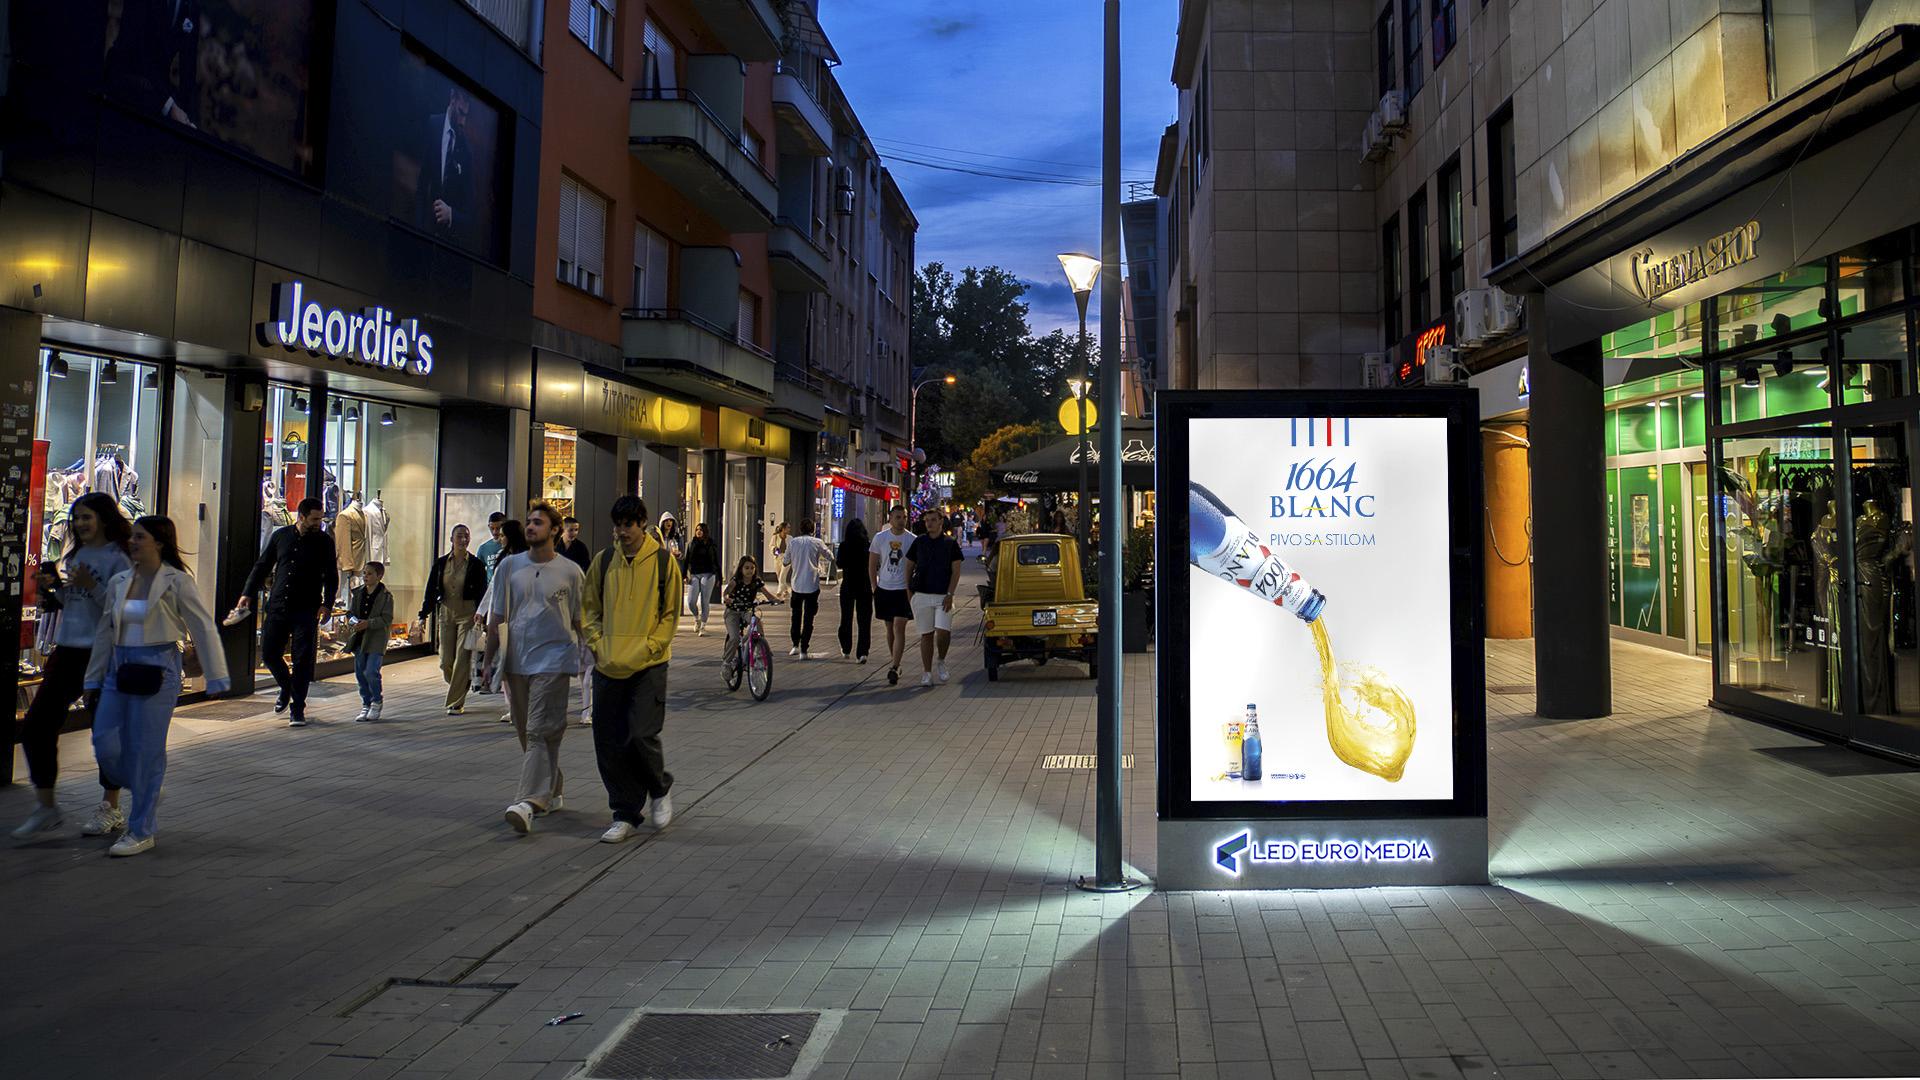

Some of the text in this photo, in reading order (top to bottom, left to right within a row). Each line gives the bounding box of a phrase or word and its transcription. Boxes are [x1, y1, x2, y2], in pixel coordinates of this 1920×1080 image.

[1706, 220, 1761, 275] SHOP
[278, 282, 434, 375] Jeordie's
[602, 380, 648, 424] ŽITOPEKA
[844, 481, 875, 496] MARKET
[1286, 457, 1358, 493] 1664
[1269, 495, 1375, 518] BLANC
[1220, 531, 1260, 582] BLANC
[1270, 533, 1376, 546] PIVO SA STILOM
[1670, 504, 1678, 598] BANKOMAT
[1255, 556, 1285, 597] 1664
[1253, 843, 1432, 860] LED EURO MEDIA
